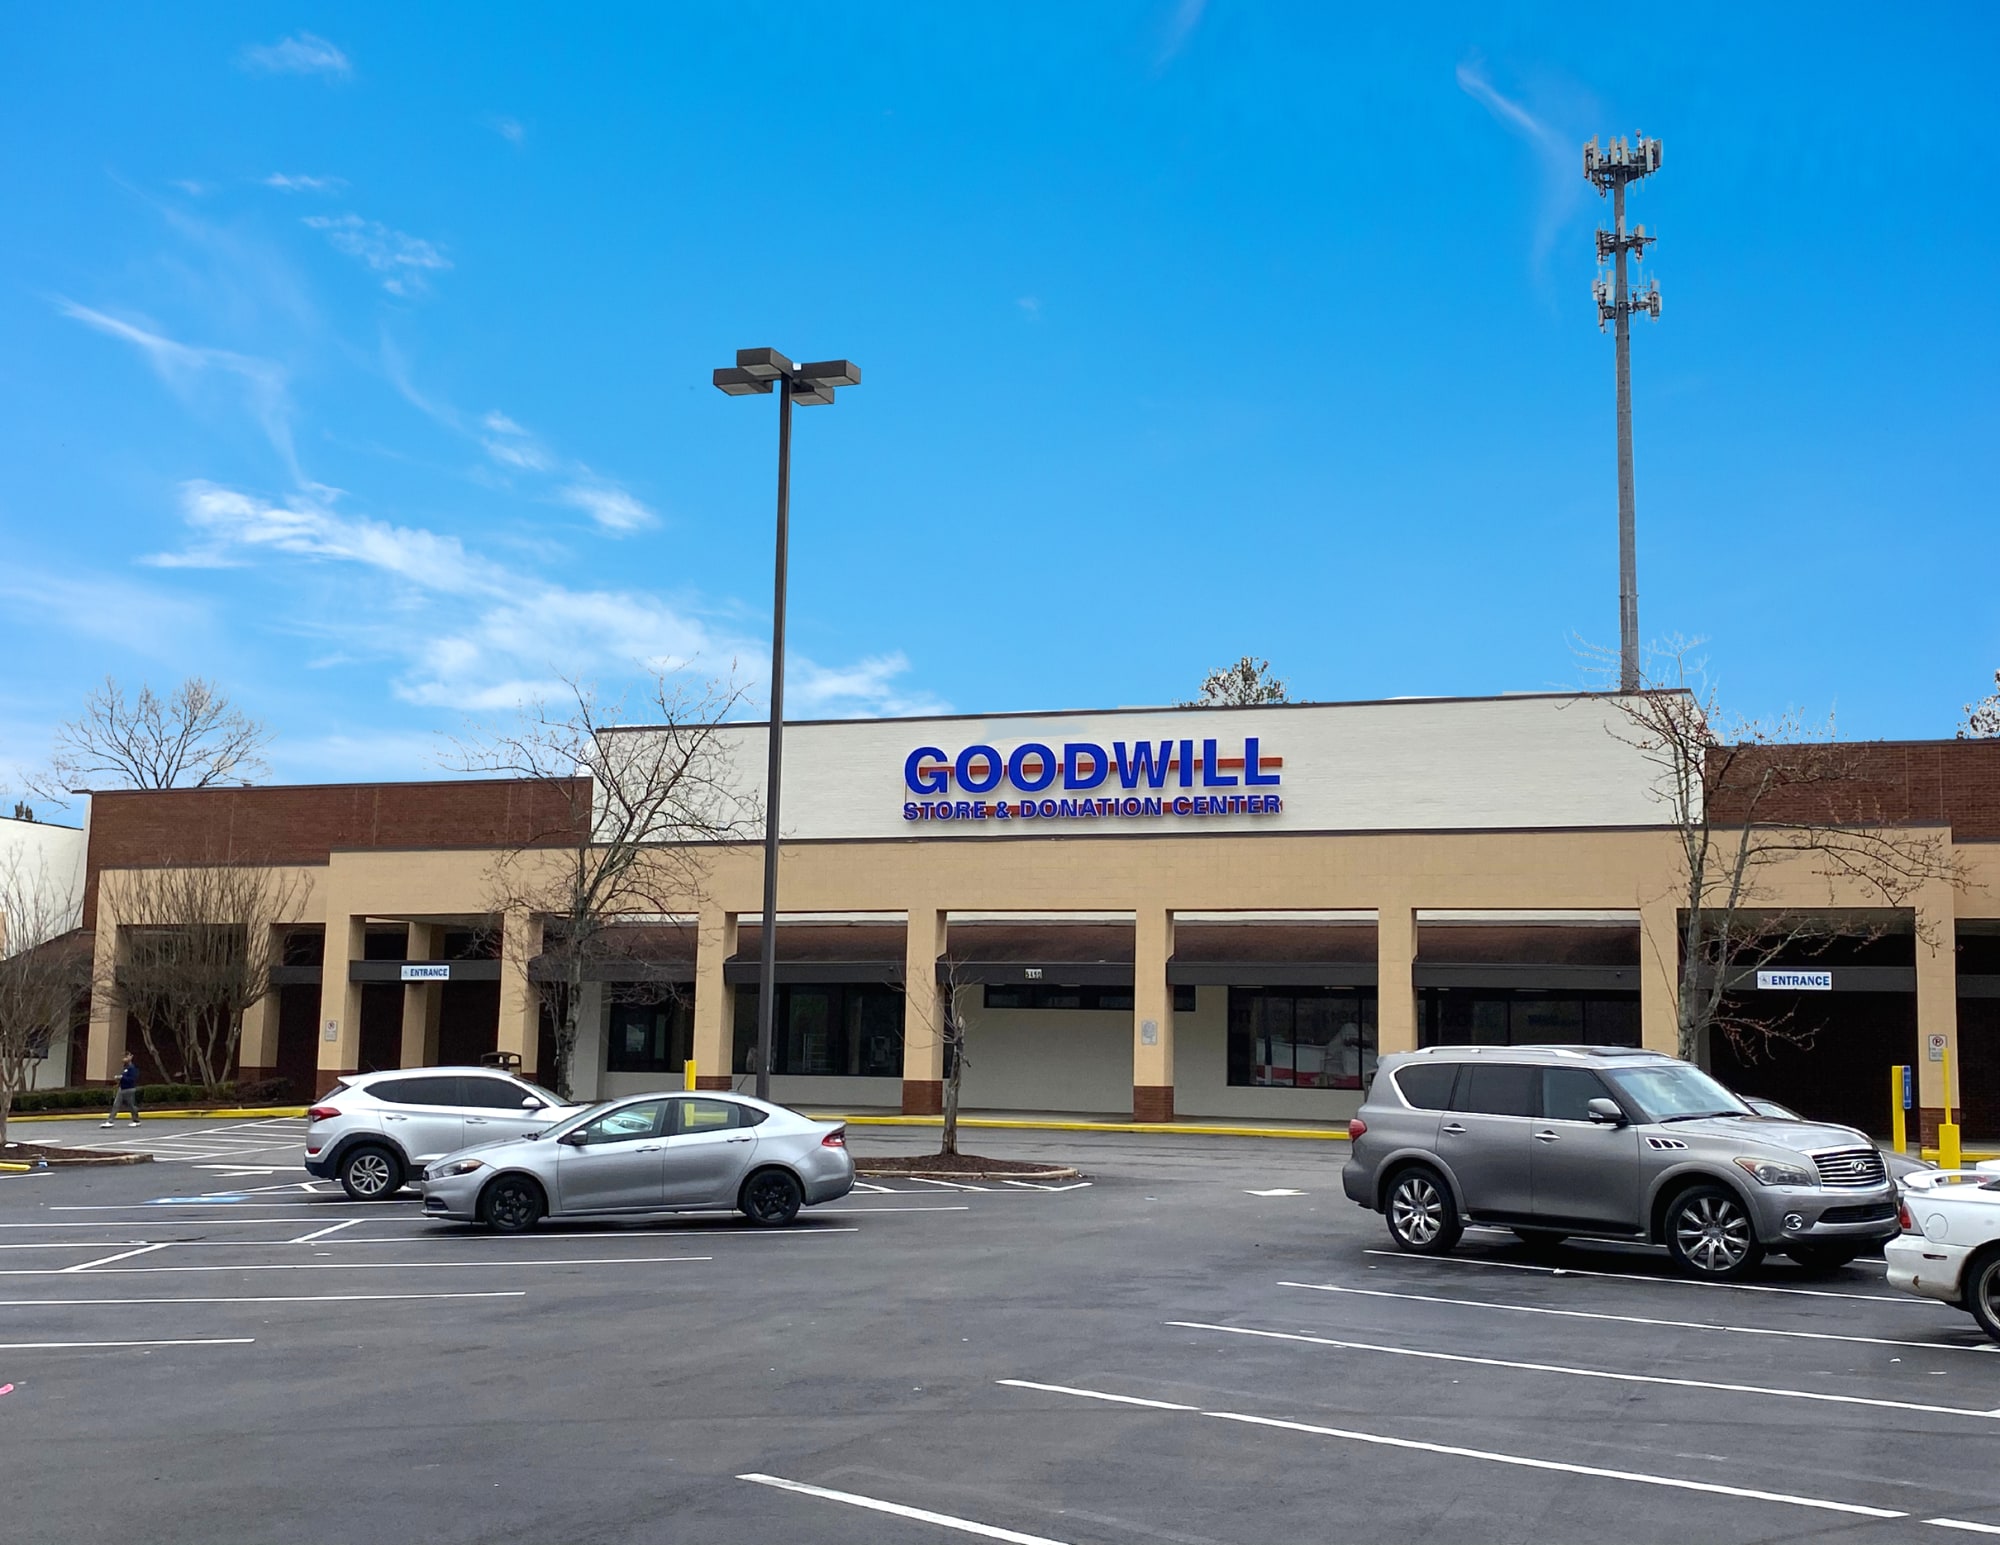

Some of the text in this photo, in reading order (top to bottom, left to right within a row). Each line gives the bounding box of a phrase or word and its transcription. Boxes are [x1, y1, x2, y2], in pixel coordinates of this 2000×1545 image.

[904, 737, 1281, 794] GOODWILL
[903, 795, 1281, 820] STORE & DONATION CENTER
[410, 968, 448, 977] ENTRANCE
[1771, 975, 1830, 986] ENTRANCE
